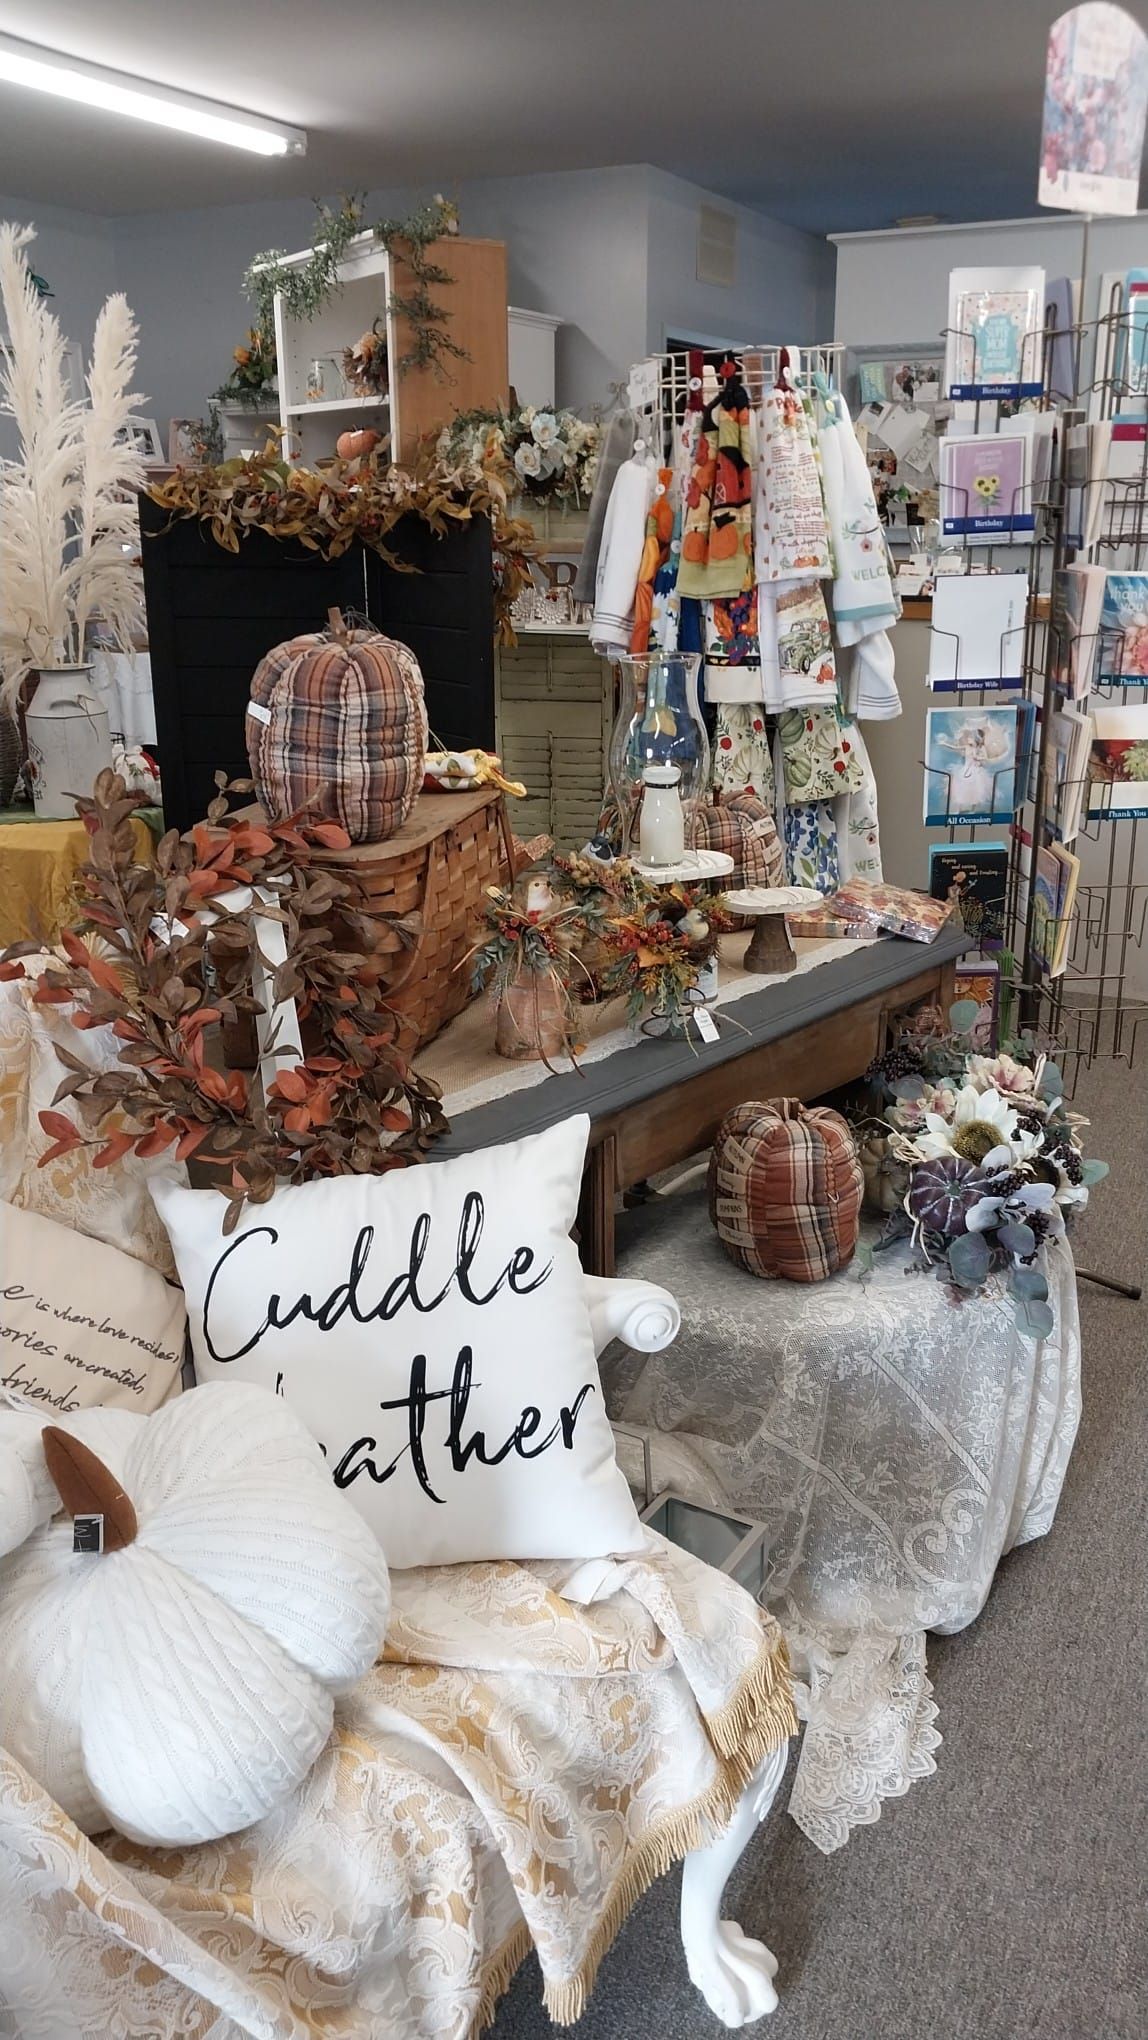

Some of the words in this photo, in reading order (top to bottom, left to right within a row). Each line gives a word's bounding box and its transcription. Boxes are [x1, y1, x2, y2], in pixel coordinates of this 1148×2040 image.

[982, 386, 1012, 395] Birthday
[975, 519, 1004, 528] Birthday
[957, 682, 983, 690] Birthday
[1120, 678, 1142, 686] Thank
[1108, 810, 1132, 819] Thank
[1133, 809, 1147, 818] You
[946, 816, 959, 825] All
[960, 815, 991, 825] Occasion
[203, 1190, 555, 1363] Cuddle
[35, 1297, 51, 1312] is
[53, 1306, 97, 1328] where
[98, 1317, 130, 1340] love
[0, 1325, 58, 1356] ories
[64, 1351, 87, 1369] are
[1, 1363, 80, 1413] friends
[318, 1345, 597, 1505] ather
